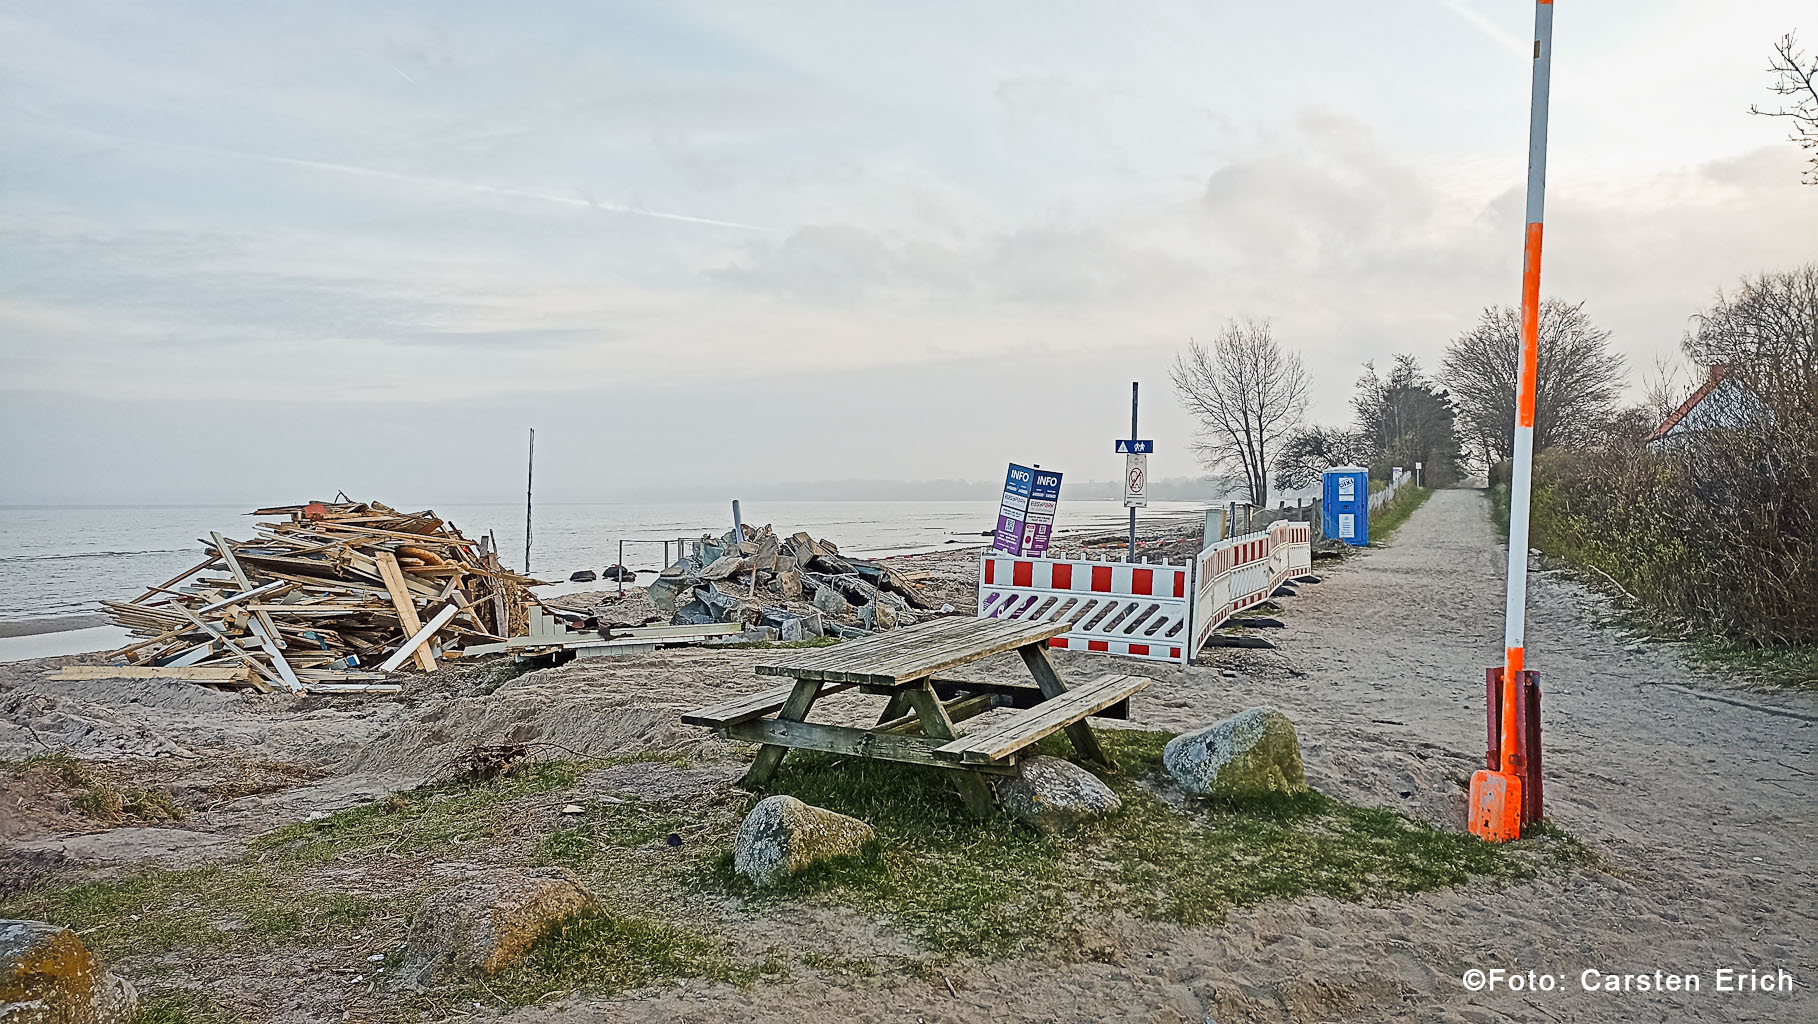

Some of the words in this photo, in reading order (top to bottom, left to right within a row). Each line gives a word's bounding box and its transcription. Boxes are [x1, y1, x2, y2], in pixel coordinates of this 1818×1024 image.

[1011, 469, 1029, 482] INFO
[1037, 475, 1057, 487] INFO
[1339, 479, 1354, 488] DIXI
